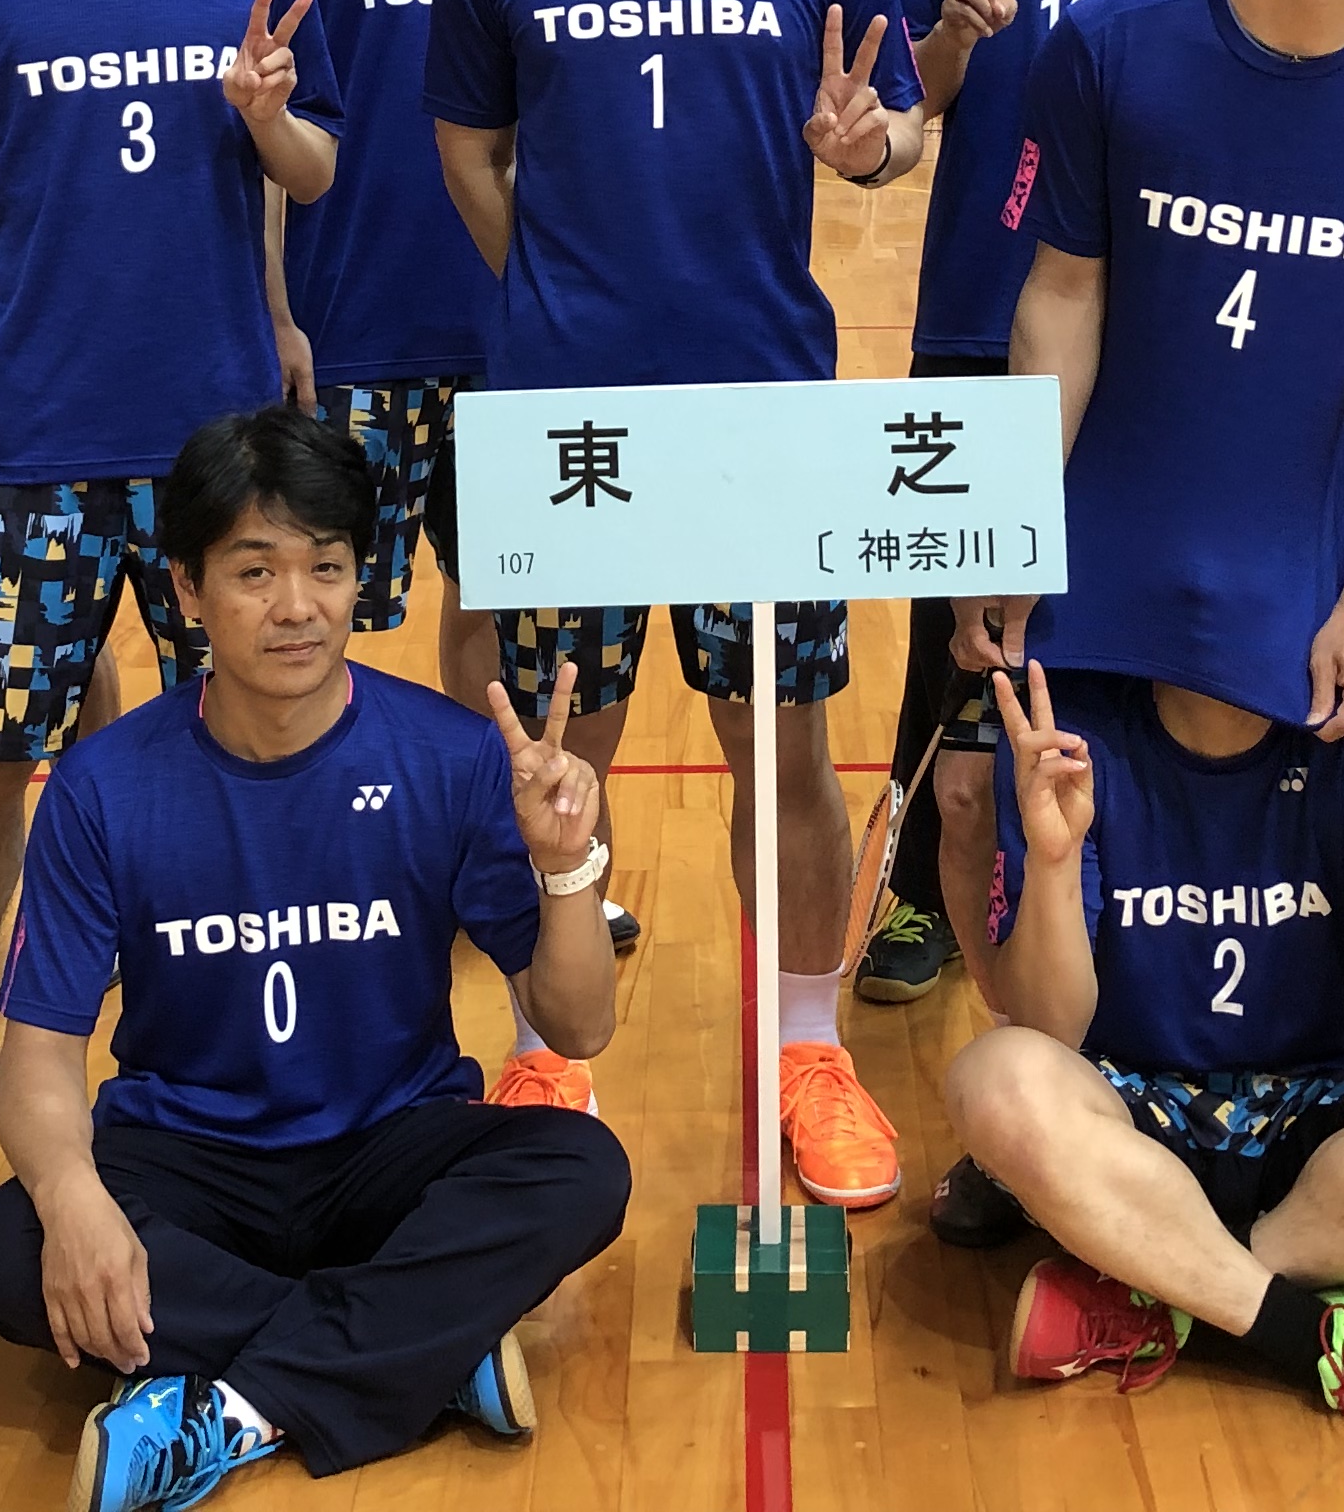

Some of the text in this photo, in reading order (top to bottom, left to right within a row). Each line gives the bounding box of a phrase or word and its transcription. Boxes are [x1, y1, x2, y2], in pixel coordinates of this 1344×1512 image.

[17, 45, 238, 96] TOSHIBA
[640, 53, 664, 129] 1
[120, 101, 156, 173] 3
[1215, 269, 1257, 350] 4
[497, 552, 534, 575] 107
[155, 899, 401, 955] TOSHIBA
[1113, 881, 1331, 927] TOSHIBA
[263, 961, 297, 1043] 0
[1211, 938, 1245, 1016] 2
